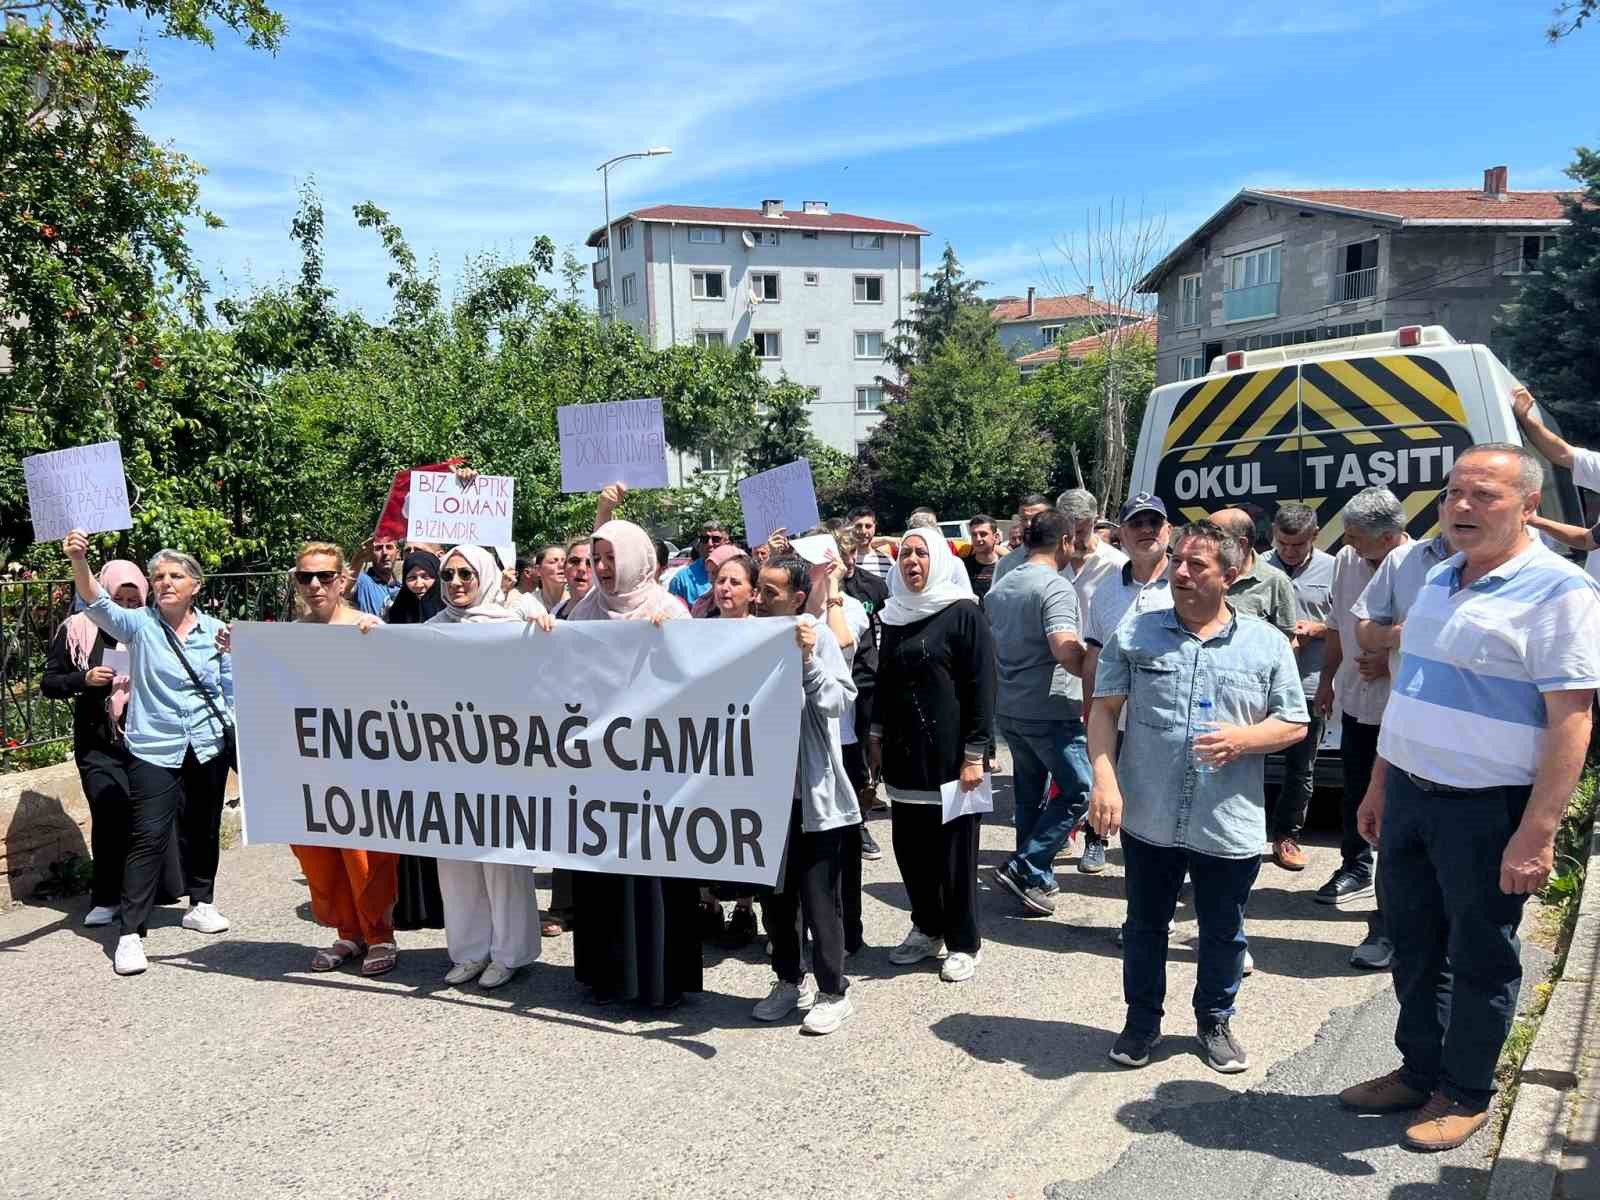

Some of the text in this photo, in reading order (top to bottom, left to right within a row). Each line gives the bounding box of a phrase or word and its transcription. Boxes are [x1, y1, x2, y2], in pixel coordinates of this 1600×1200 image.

[434, 496, 506, 517] LOJMAN
[1174, 462, 1277, 500] OKUL
[294, 700, 755, 777] ENGÜRÜBAĞ CAMİİ
[302, 783, 765, 868] LOJMANINI İSTİYOR
